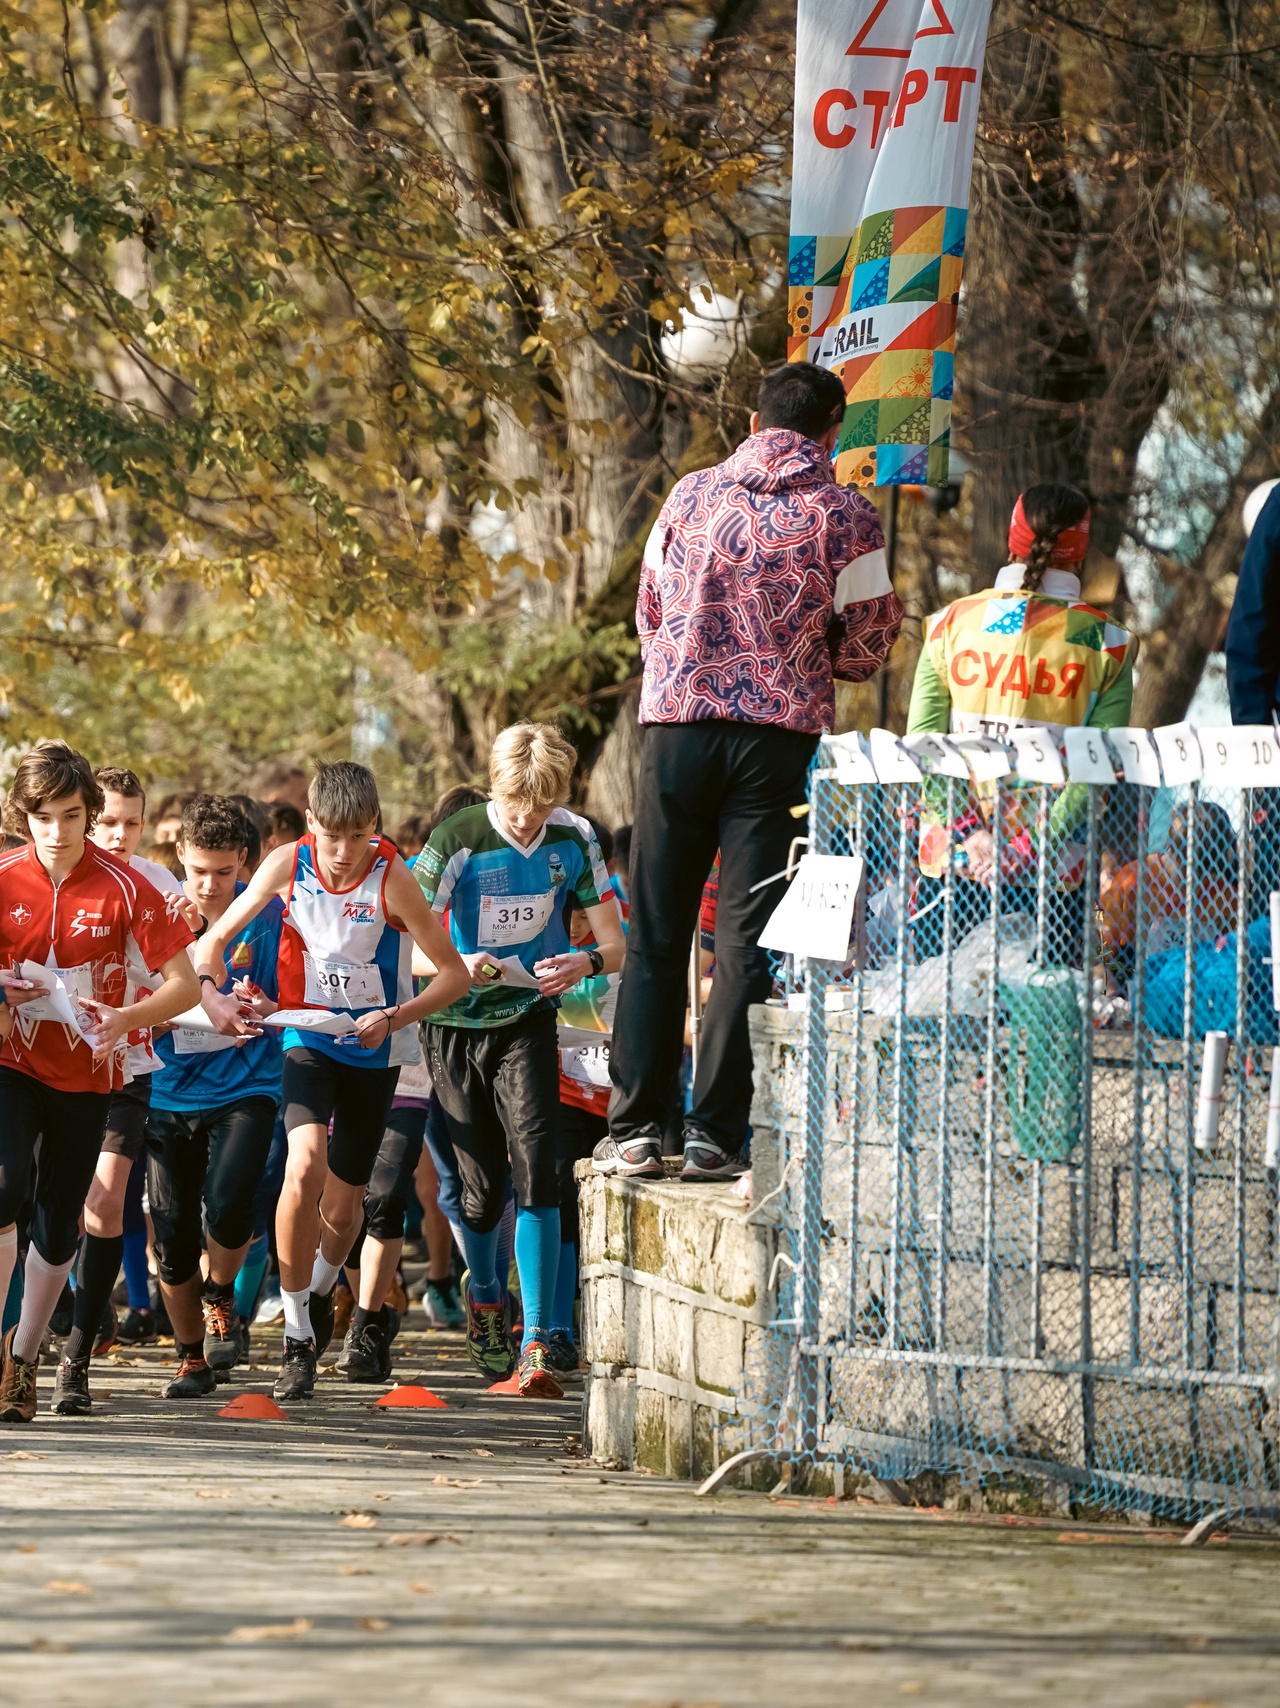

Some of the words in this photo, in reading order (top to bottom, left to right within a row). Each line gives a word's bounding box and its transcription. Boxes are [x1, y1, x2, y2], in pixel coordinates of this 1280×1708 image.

[813, 66, 977, 150] СТРТ
[950, 649, 1086, 700] СУДЬЯ
[1030, 741, 1044, 762] 5
[1087, 740, 1098, 764] 6
[1129, 741, 1140, 763] 7
[1175, 738, 1187, 761] 8
[1216, 742, 1227, 765] 9
[1252, 741, 1273, 765] 10
[498, 907, 534, 923] 313
[492, 923, 517, 931] МЖ14
[318, 971, 351, 989] 307
[361, 980, 367, 989] 1
[579, 1047, 610, 1061] 319
